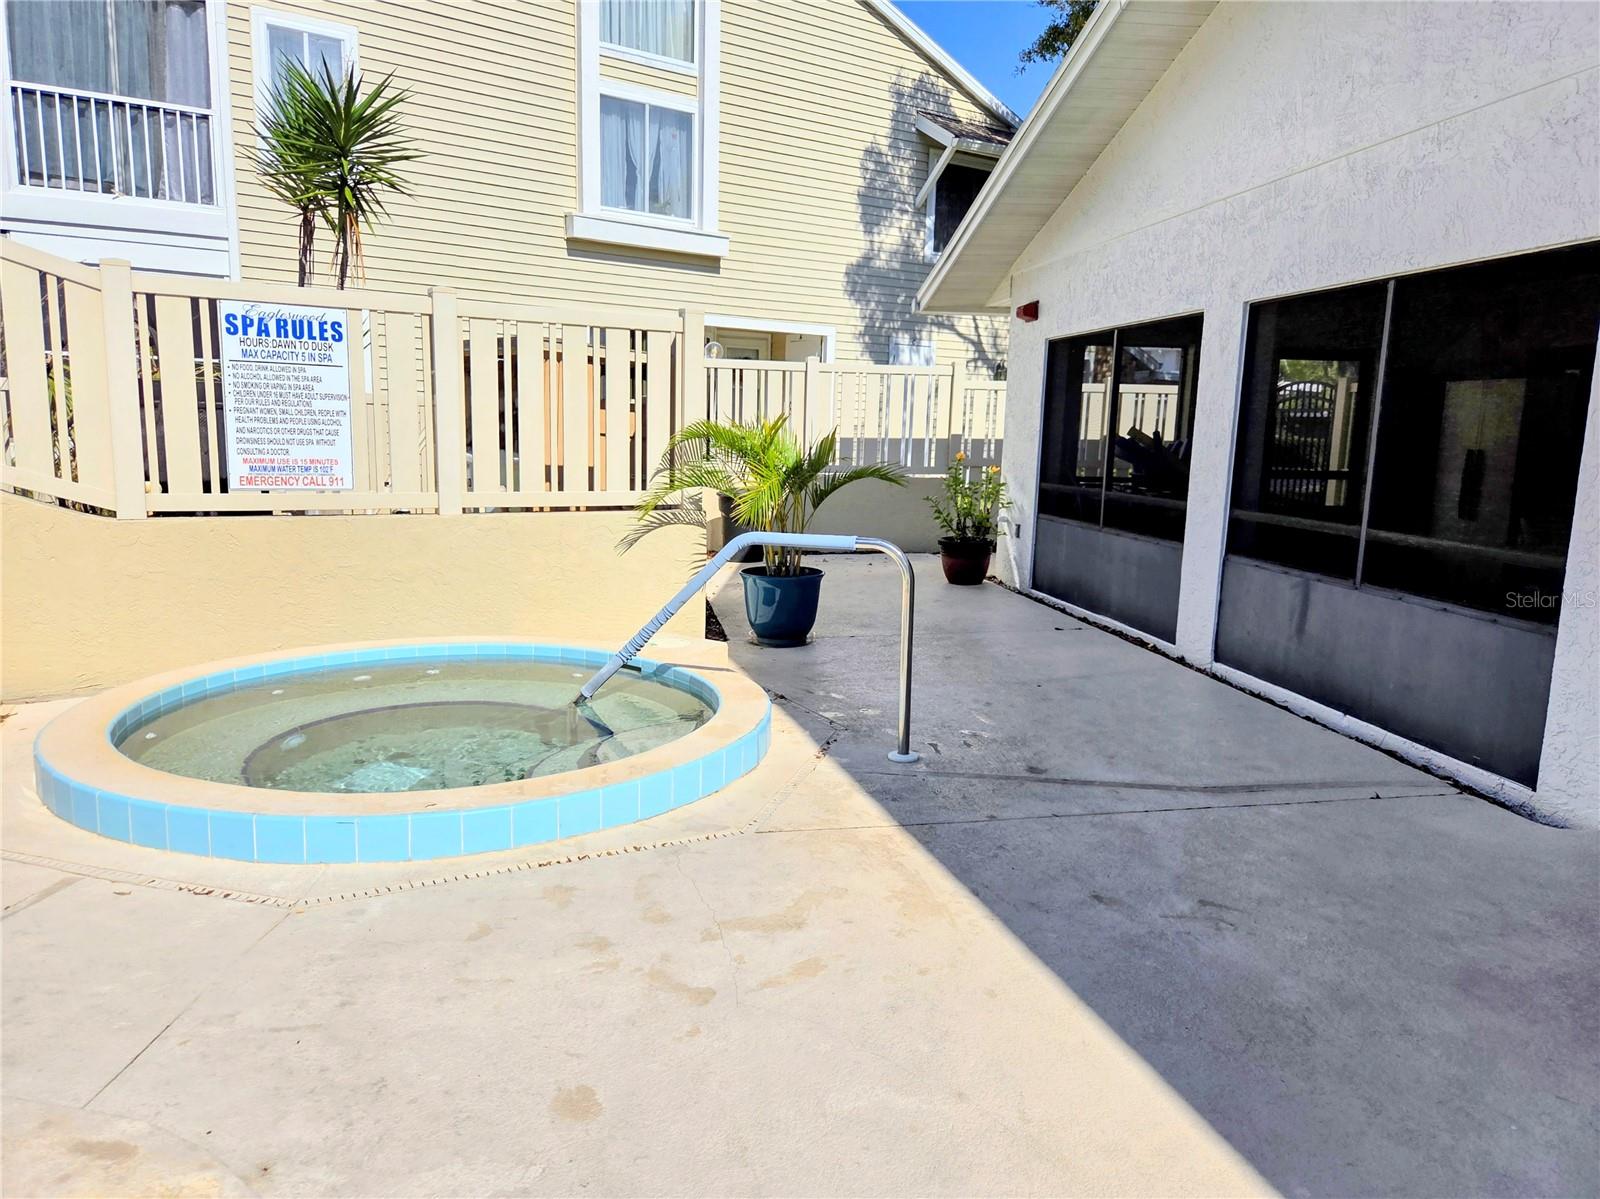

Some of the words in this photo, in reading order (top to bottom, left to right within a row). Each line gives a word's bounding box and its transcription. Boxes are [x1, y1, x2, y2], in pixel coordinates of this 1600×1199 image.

[225, 313, 270, 337] SPA
[276, 318, 343, 342] RULES
[300, 341, 309, 350] TO
[312, 342, 333, 352] DUSK
[242, 349, 258, 359] MAX
[261, 350, 299, 361] CAPACITY
[302, 352, 306, 361] 5
[308, 352, 315, 362] IN
[318, 353, 332, 363] SPA
[240, 476, 300, 486] EMERGENCY
[303, 477, 326, 486] CALL
[329, 477, 344, 486] 911
